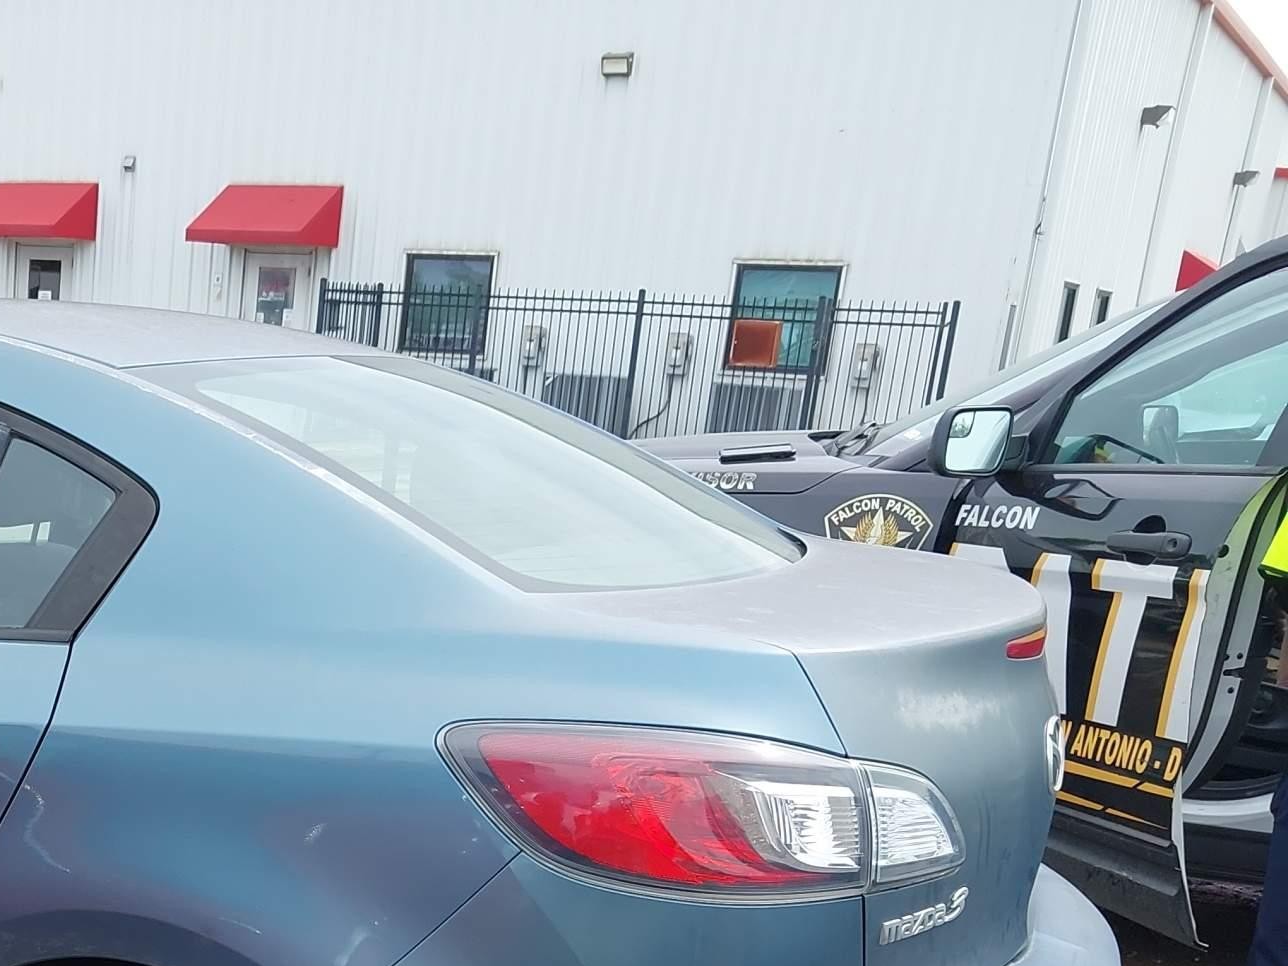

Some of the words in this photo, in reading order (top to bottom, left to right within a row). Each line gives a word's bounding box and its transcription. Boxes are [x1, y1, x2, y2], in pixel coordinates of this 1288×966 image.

[830, 498, 880, 526] FALCON
[885, 498, 927, 533] PATROL
[954, 503, 1041, 530] FALCON
[1070, 723, 1153, 774] ANTONIO
